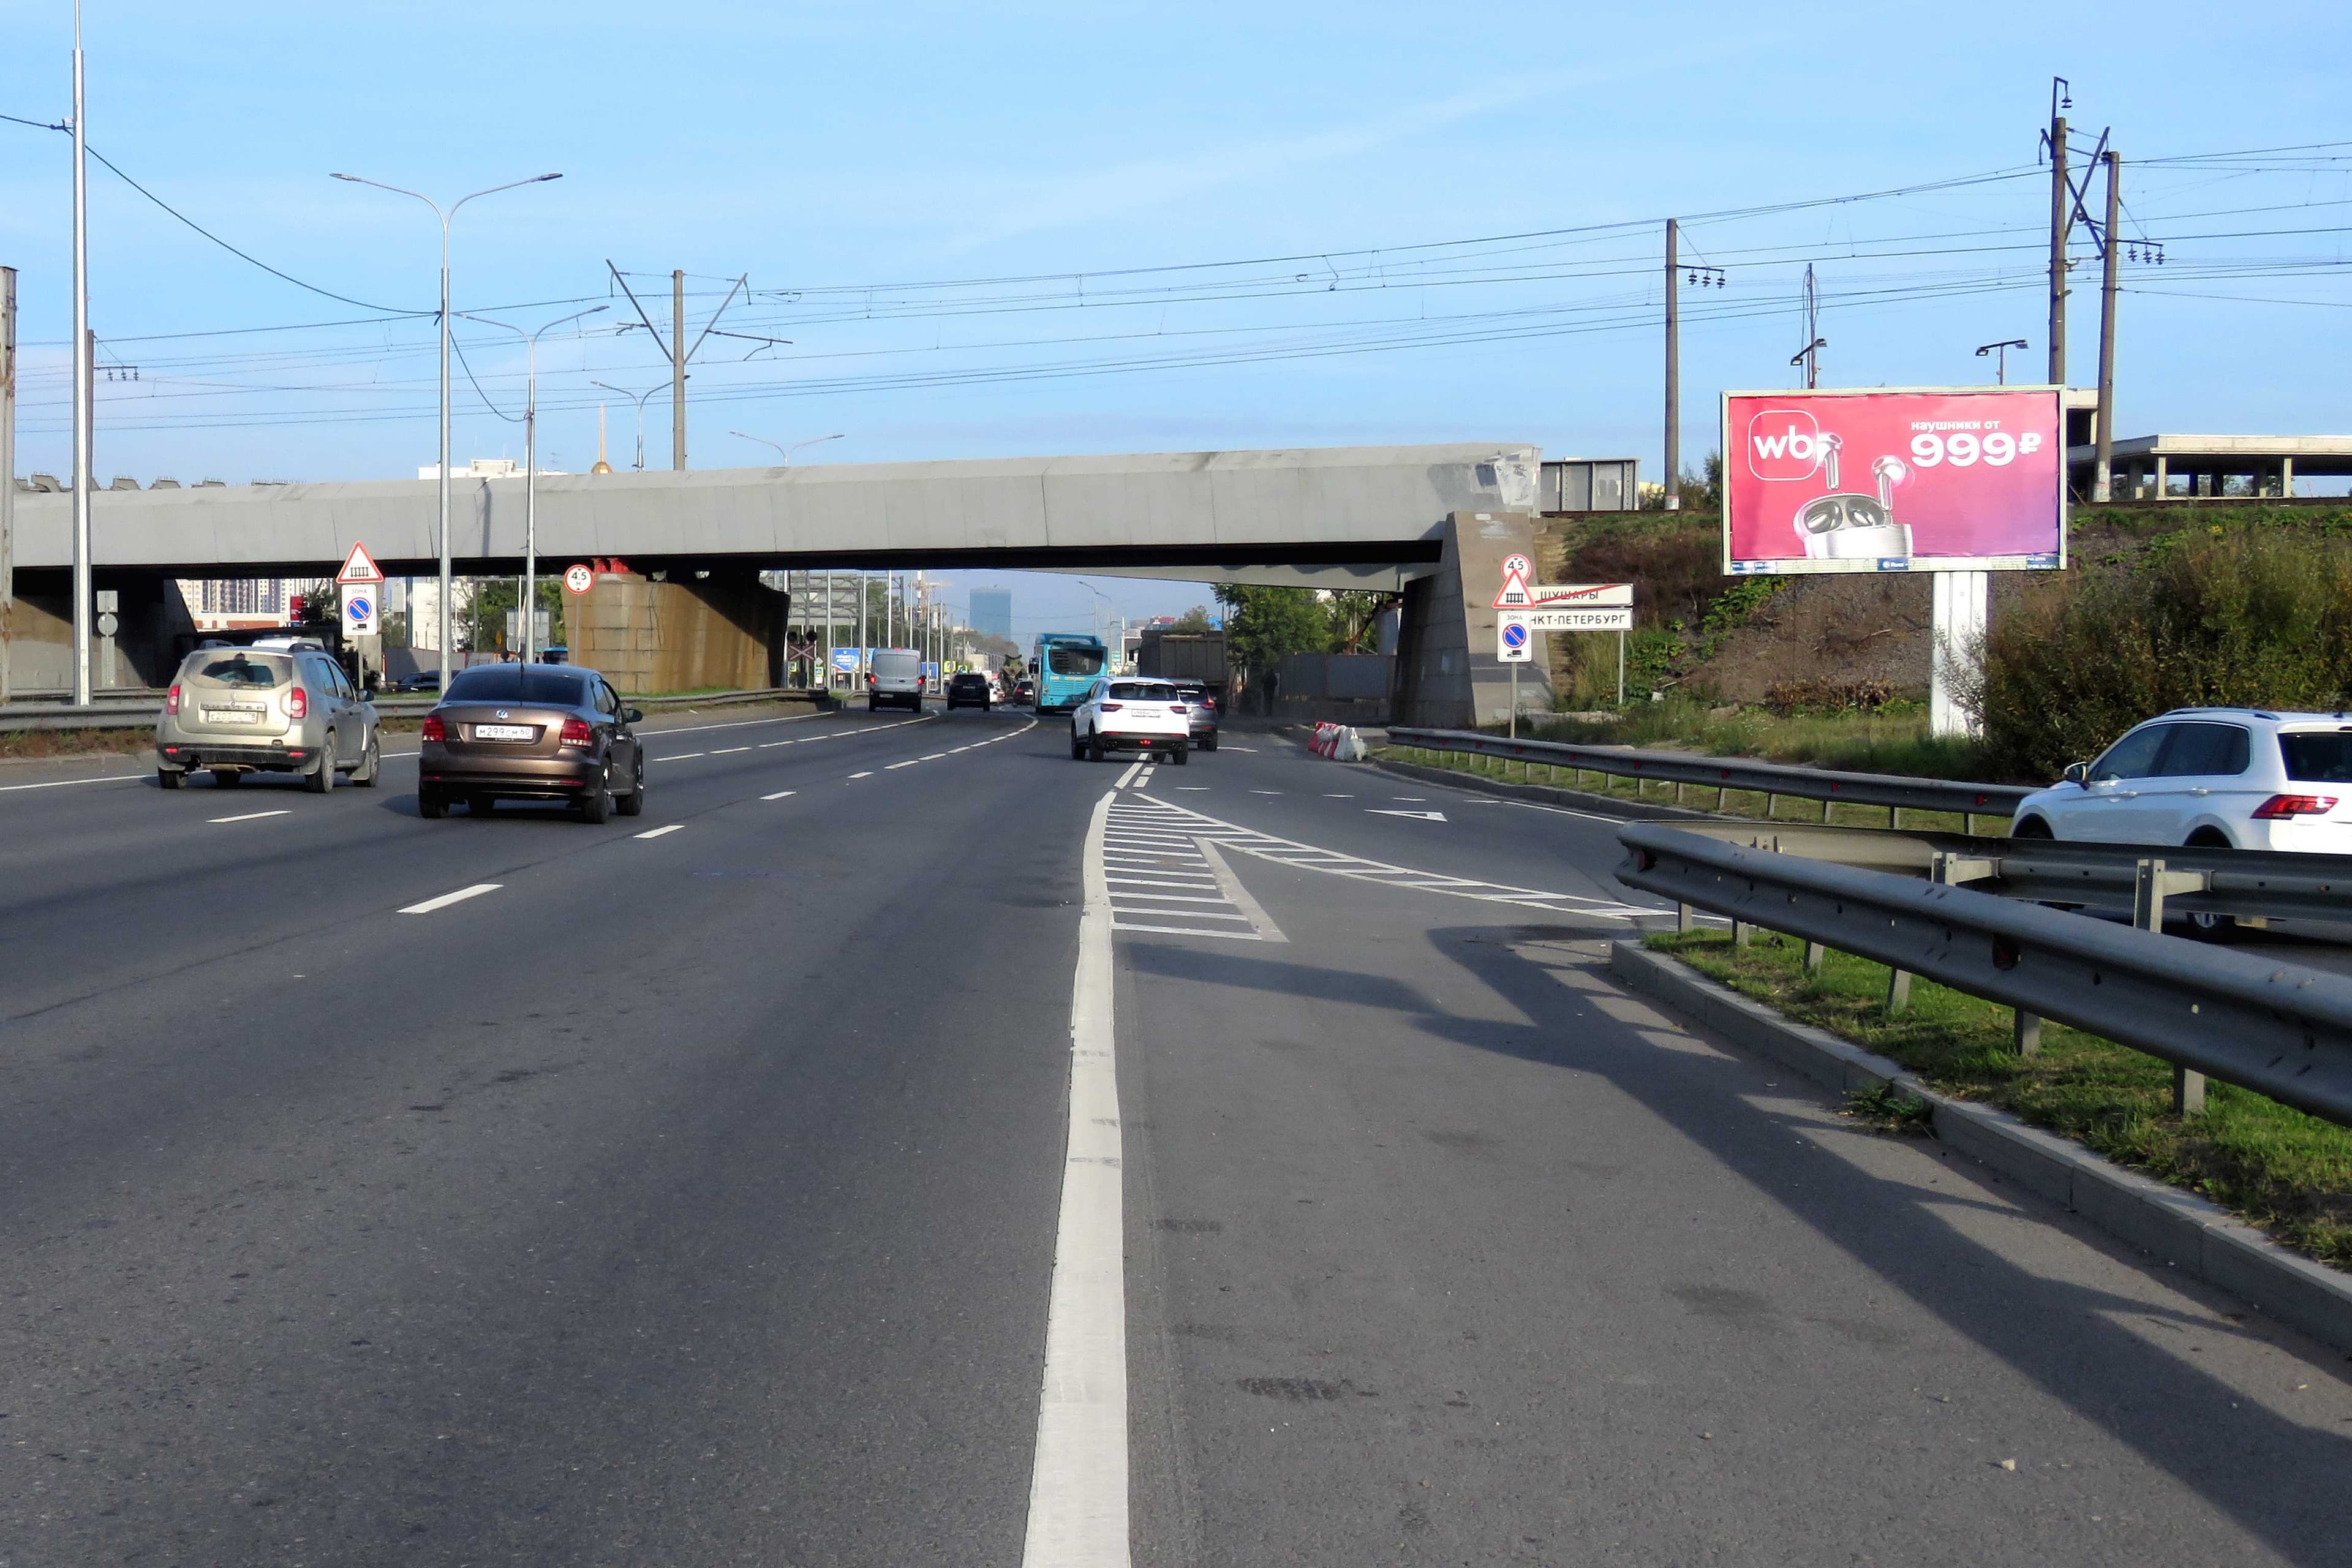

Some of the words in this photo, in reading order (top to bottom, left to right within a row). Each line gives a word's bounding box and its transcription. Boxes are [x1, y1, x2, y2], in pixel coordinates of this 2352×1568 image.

[1910, 421, 1981, 433] наушники
[1984, 420, 2000, 430] от
[1752, 425, 1814, 460] wb
[1508, 561, 1523, 570] 45
[1540, 590, 1599, 600] ШУШАРЫ
[1531, 615, 1626, 625] НКТ-ПЕТЕРБУРГ
